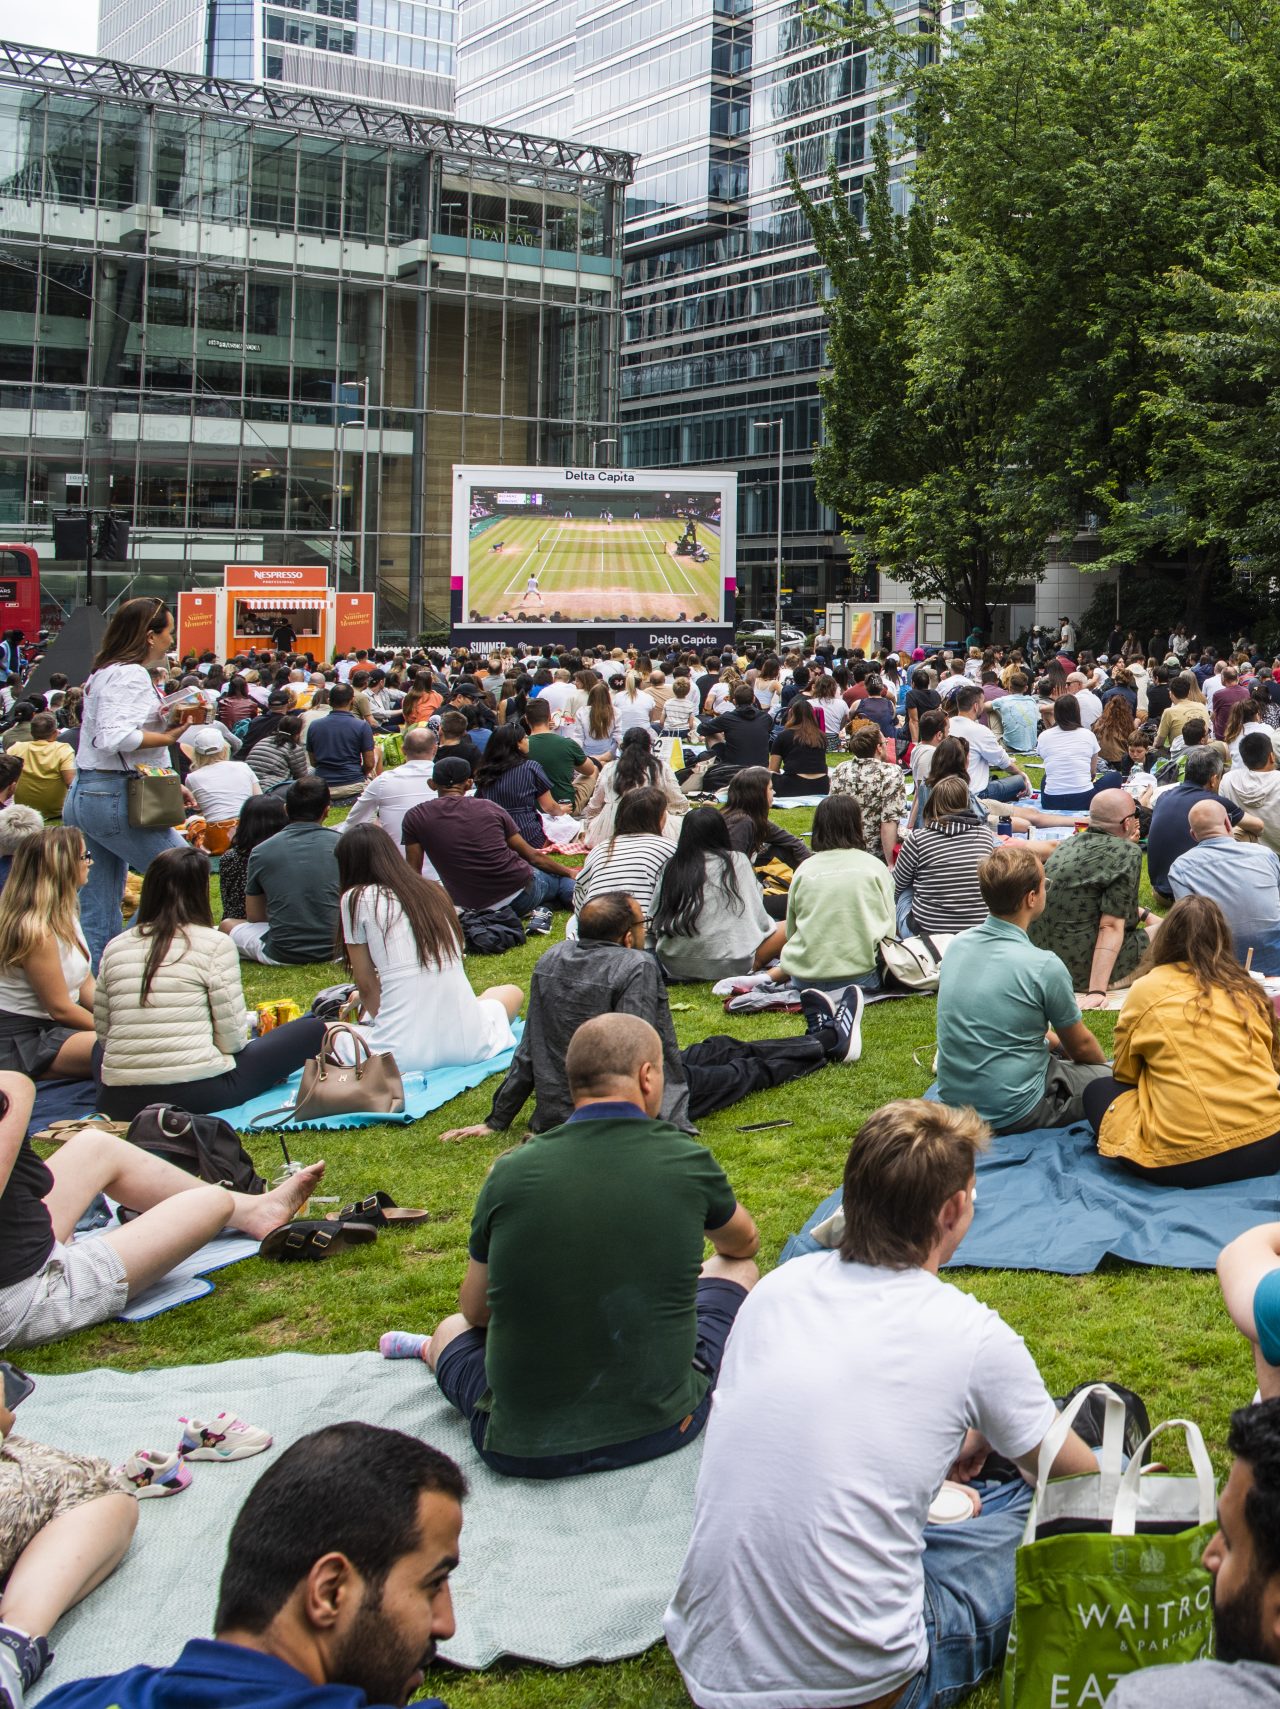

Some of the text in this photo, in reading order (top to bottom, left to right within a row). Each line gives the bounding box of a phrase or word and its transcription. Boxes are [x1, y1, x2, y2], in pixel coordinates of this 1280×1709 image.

[566, 471, 634, 483] Delta Capita
[253, 570, 302, 578] NESPRESSO
[650, 633, 717, 647] Delta Capita
[470, 642, 506, 653] SUMMER
[1078, 1585, 1210, 1629] WAITRO
[1120, 1641, 1128, 1651] &
[1051, 1673, 1122, 1709] EA
